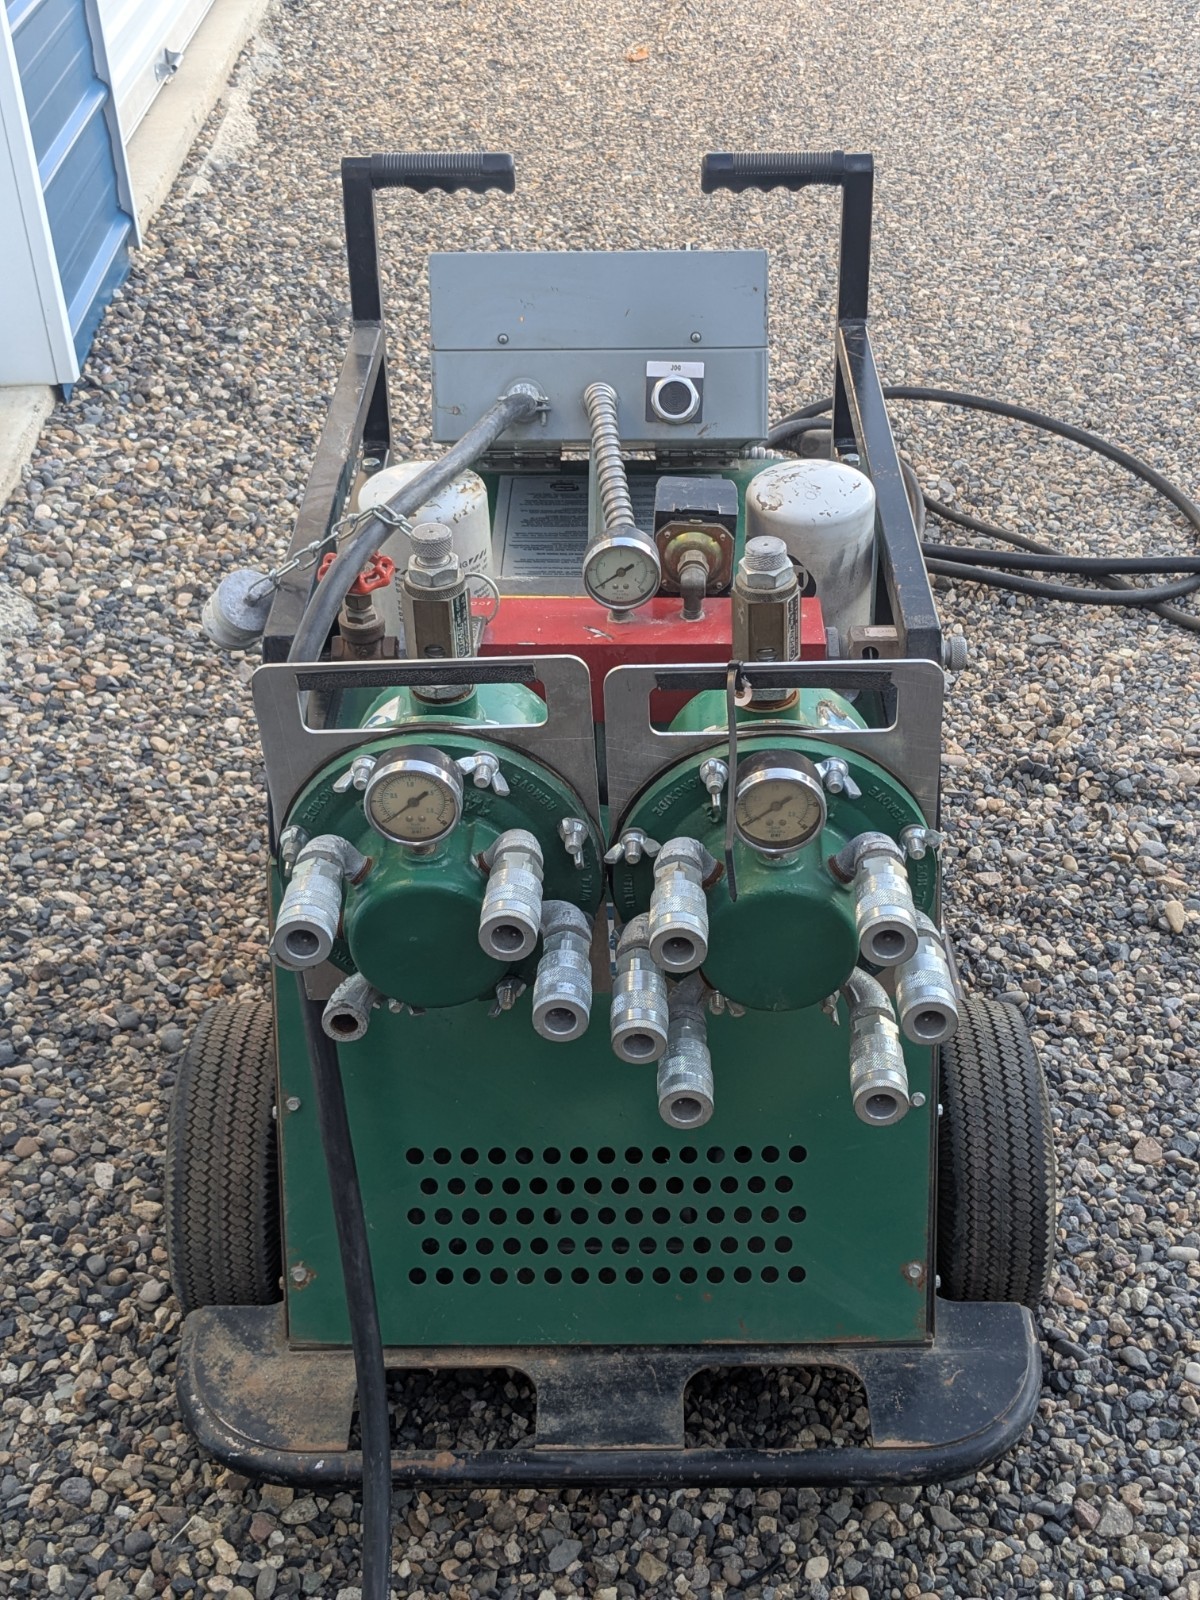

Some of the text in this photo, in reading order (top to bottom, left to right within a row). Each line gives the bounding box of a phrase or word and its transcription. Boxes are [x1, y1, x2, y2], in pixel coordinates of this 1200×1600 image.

[509, 774, 558, 811] REMOVE
[652, 775, 701, 818] ONOXIDE
[867, 785, 910, 825] REMOVE
